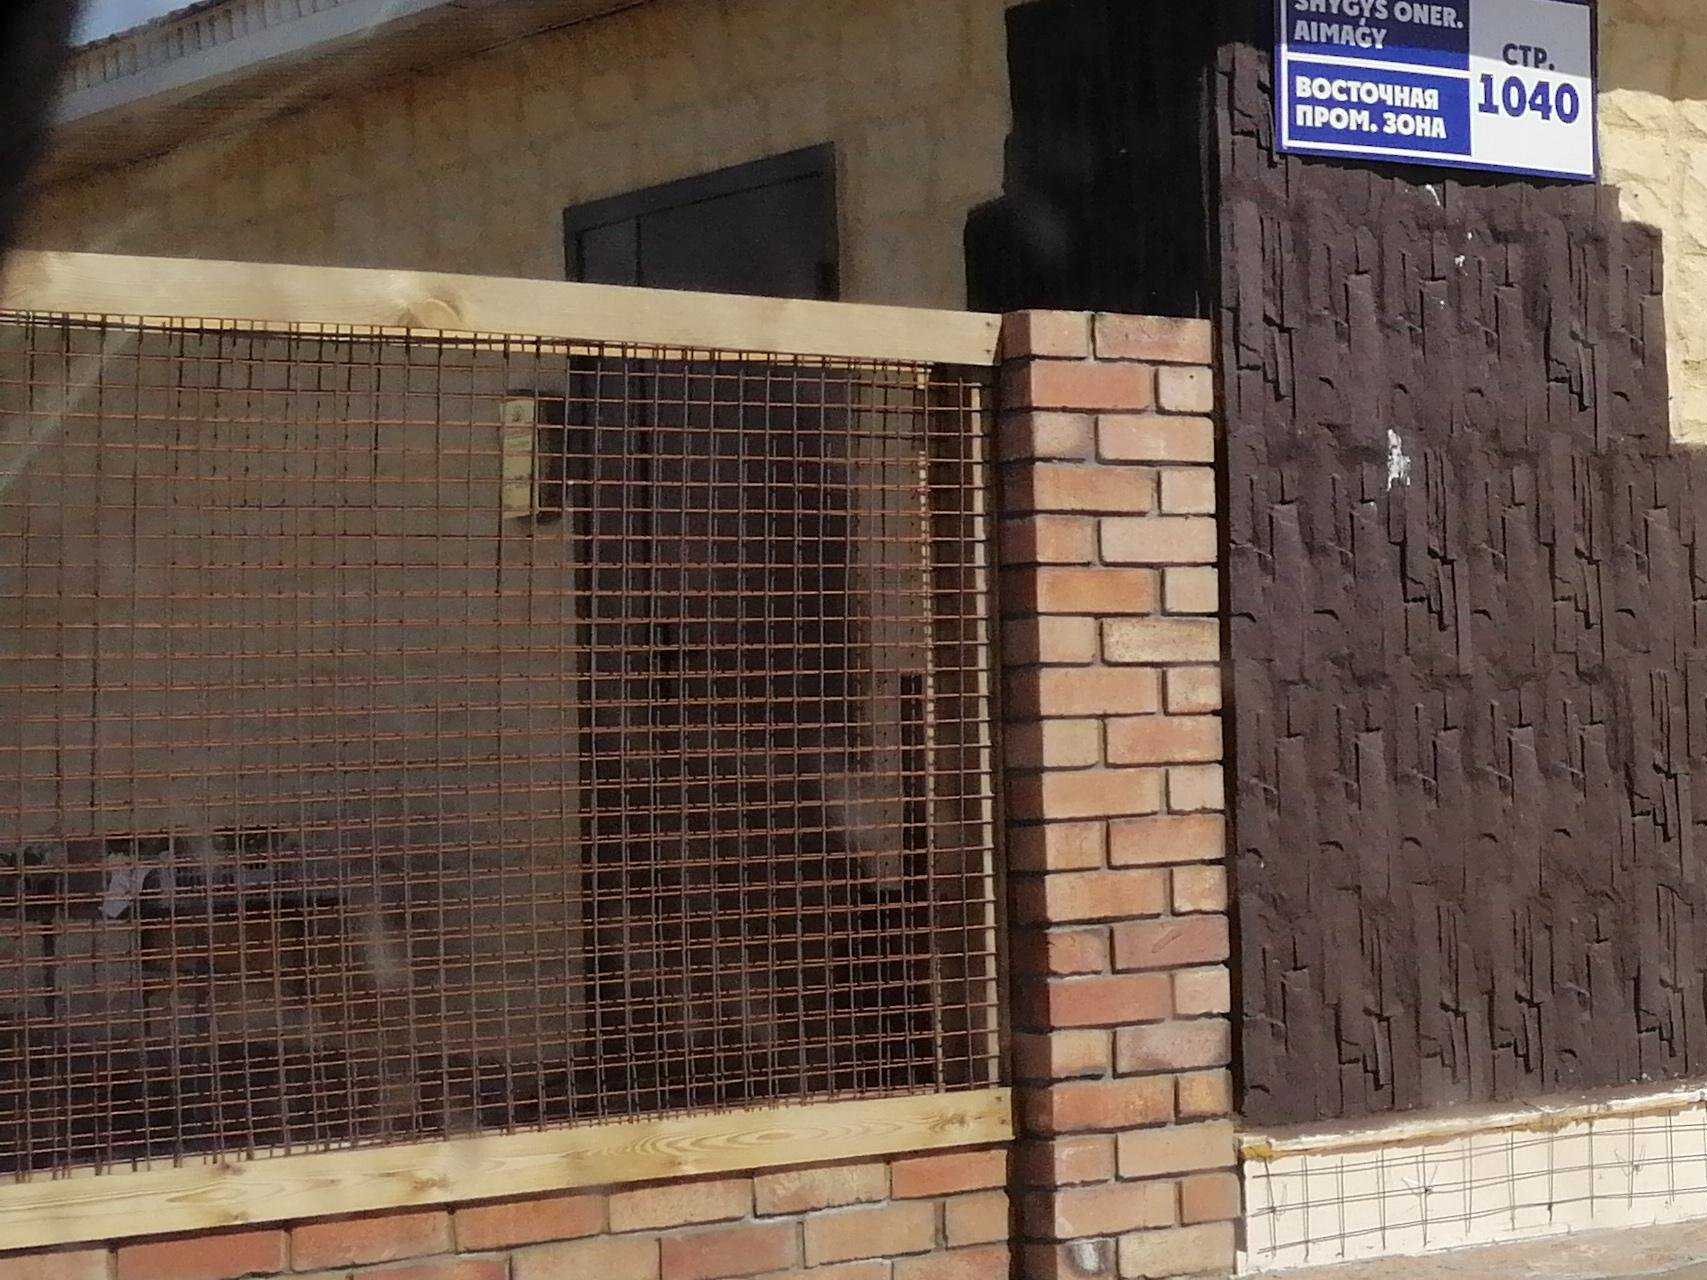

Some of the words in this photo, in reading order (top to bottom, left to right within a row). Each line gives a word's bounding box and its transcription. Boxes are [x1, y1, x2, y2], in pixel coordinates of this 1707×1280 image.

[1502, 43, 1556, 71] СТР.
[1295, 75, 1440, 112] ВОСТОЧНАЯ
[1477, 73, 1580, 125] 1040
[1295, 104, 1378, 133] ПРОМ.
[1382, 111, 1448, 140] ЗОНА
